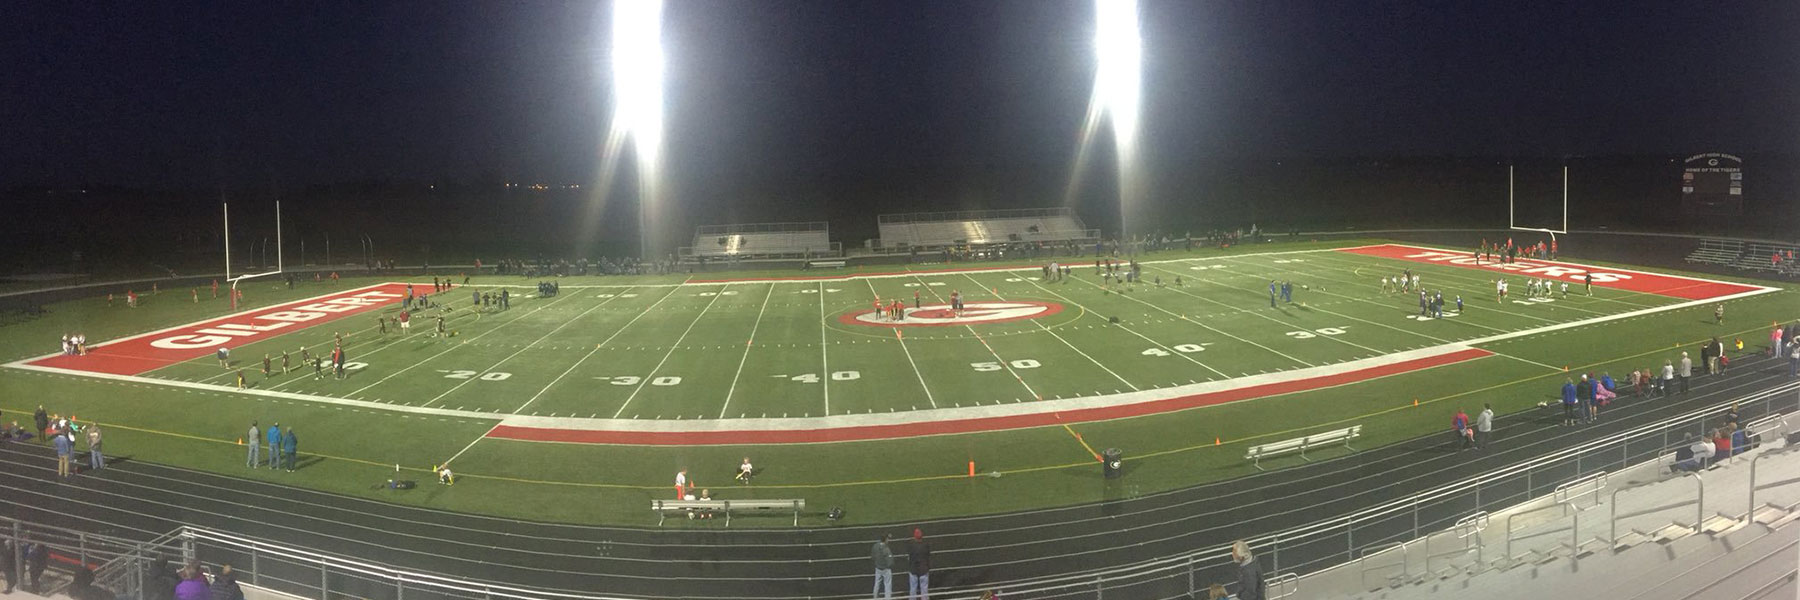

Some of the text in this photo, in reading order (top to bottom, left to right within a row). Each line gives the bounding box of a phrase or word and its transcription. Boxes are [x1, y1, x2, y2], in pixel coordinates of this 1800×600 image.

[1708, 158, 1719, 166] G
[1404, 252, 1632, 282] TIGERS
[150, 291, 403, 349] GILBERT
[1286, 327, 1346, 338] 30
[1141, 343, 1205, 356] 40
[970, 359, 1042, 371] 50
[444, 370, 512, 381] 20
[610, 376, 682, 386] 30
[791, 371, 861, 383] 40
